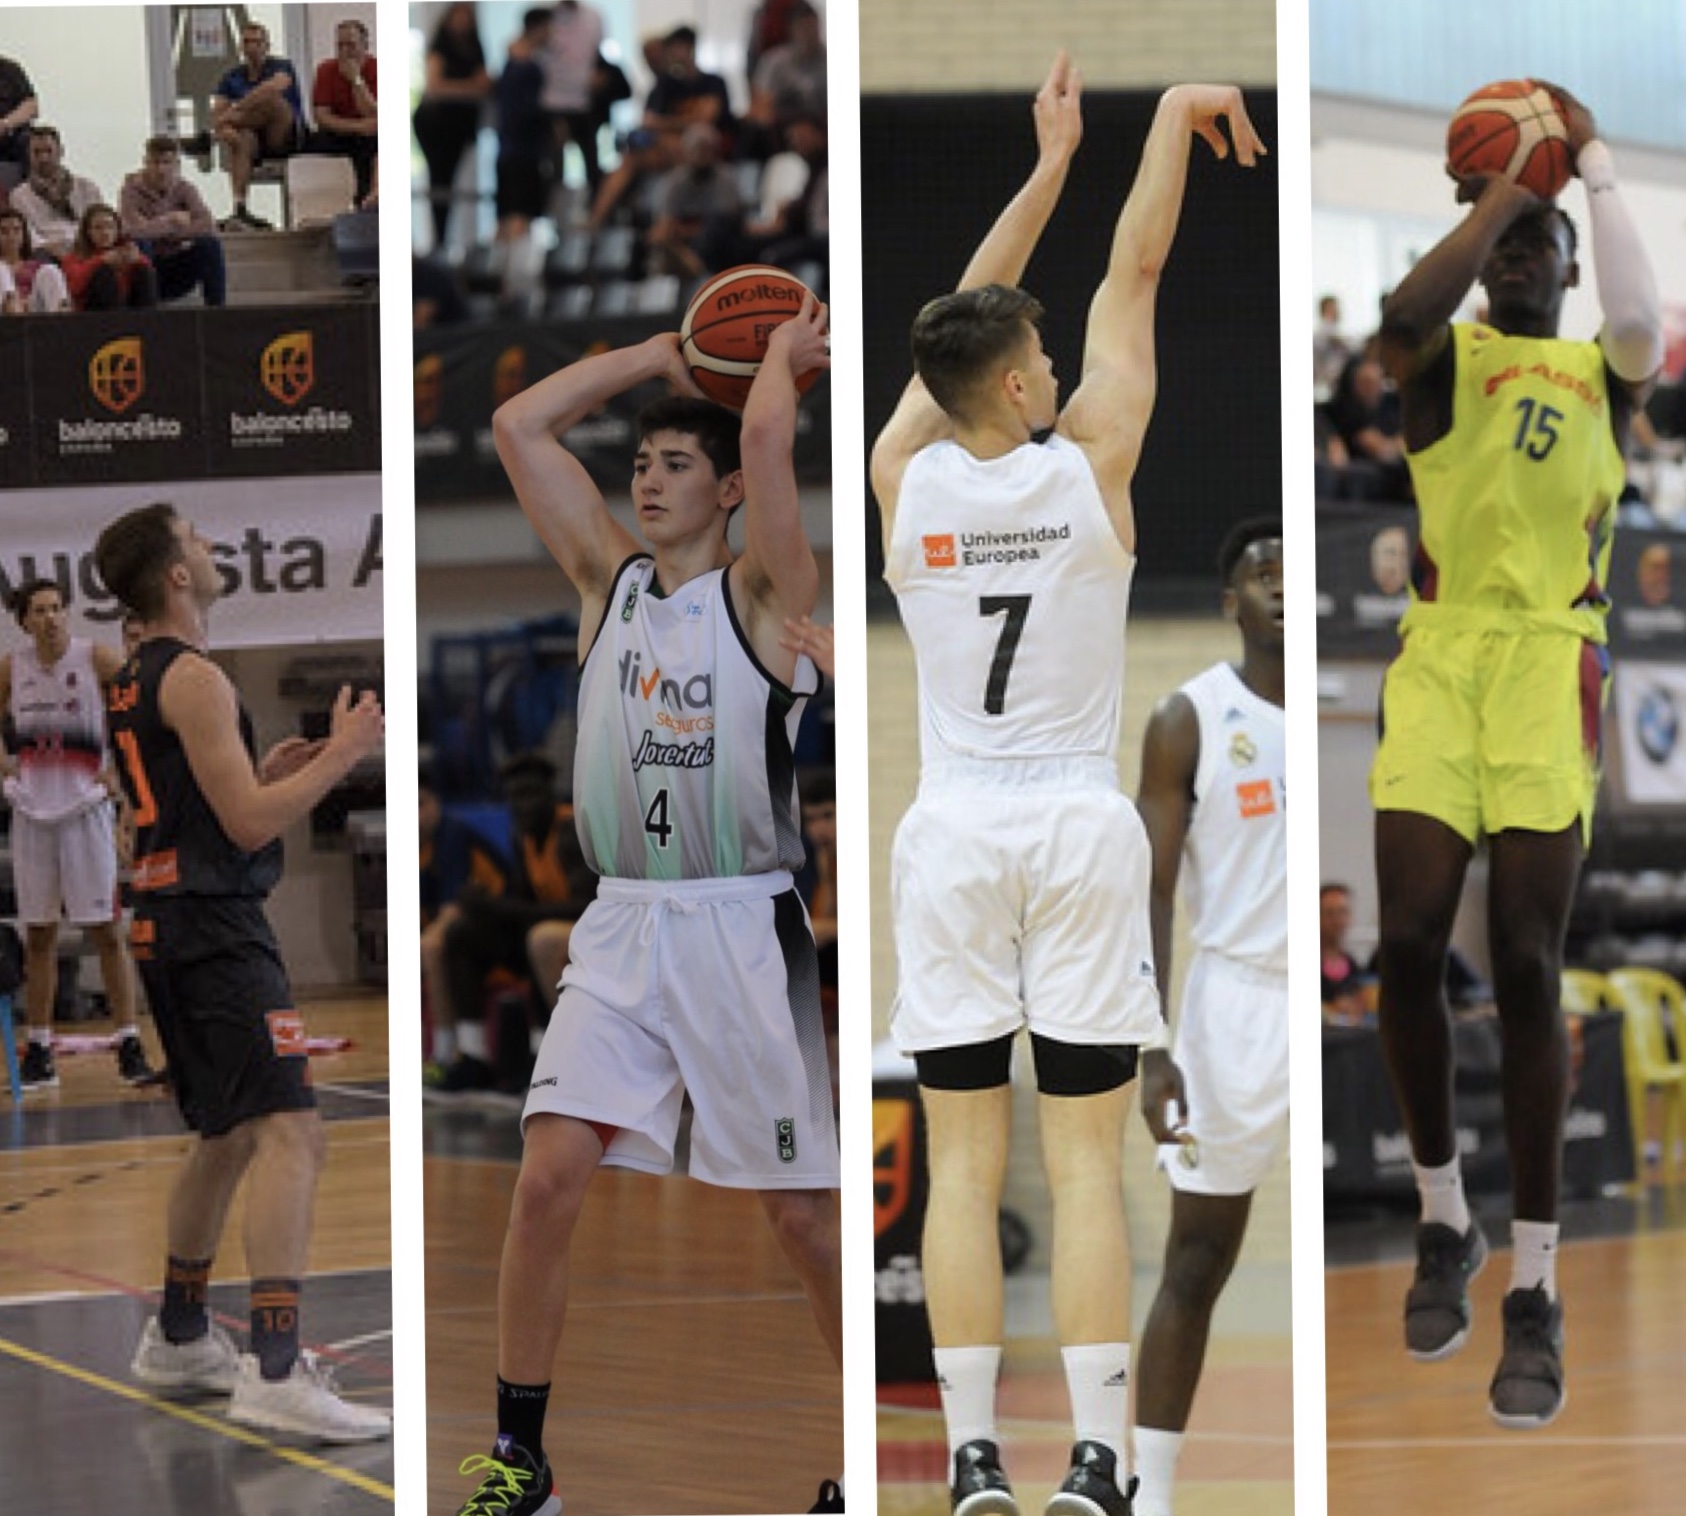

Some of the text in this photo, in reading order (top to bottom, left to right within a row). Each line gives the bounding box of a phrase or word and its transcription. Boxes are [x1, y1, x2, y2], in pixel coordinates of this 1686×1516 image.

[716, 284, 800, 312] molten
[1513, 397, 1565, 462] 15
[961, 524, 1071, 547] Universidad
[963, 548, 1040, 566] Europea
[979, 595, 1032, 715] 7
[619, 649, 712, 711] divna
[655, 711, 714, 735] seguros
[644, 788, 673, 848] 4
[779, 1122, 793, 1159] CJB
